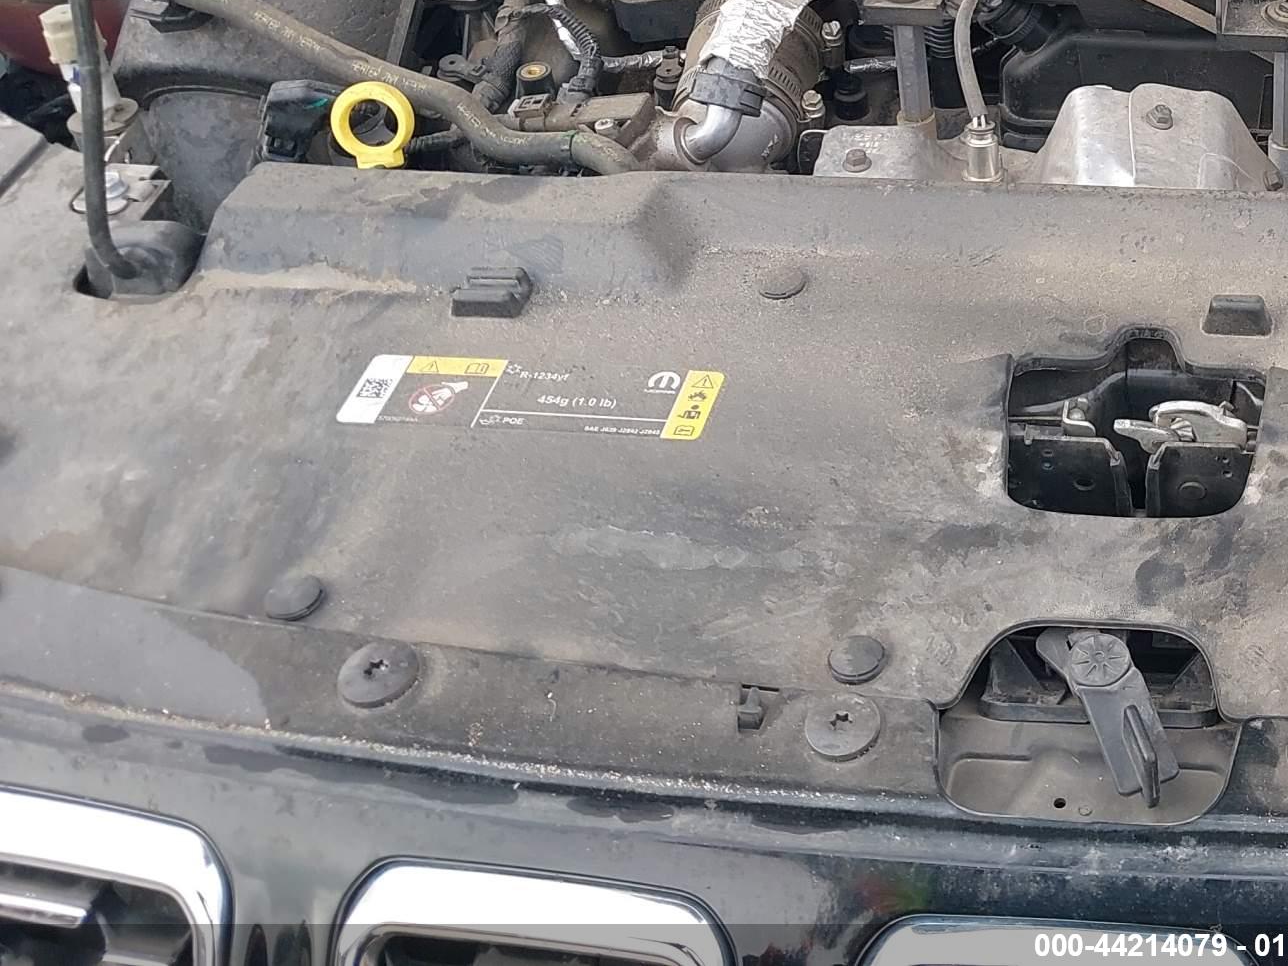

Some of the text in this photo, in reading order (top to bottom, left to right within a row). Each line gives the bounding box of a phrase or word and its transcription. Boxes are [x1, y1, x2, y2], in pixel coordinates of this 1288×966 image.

[519, 370, 570, 382] R-1234yf
[536, 394, 617, 410] 454g (1.0 lb)
[502, 417, 526, 426] POE
